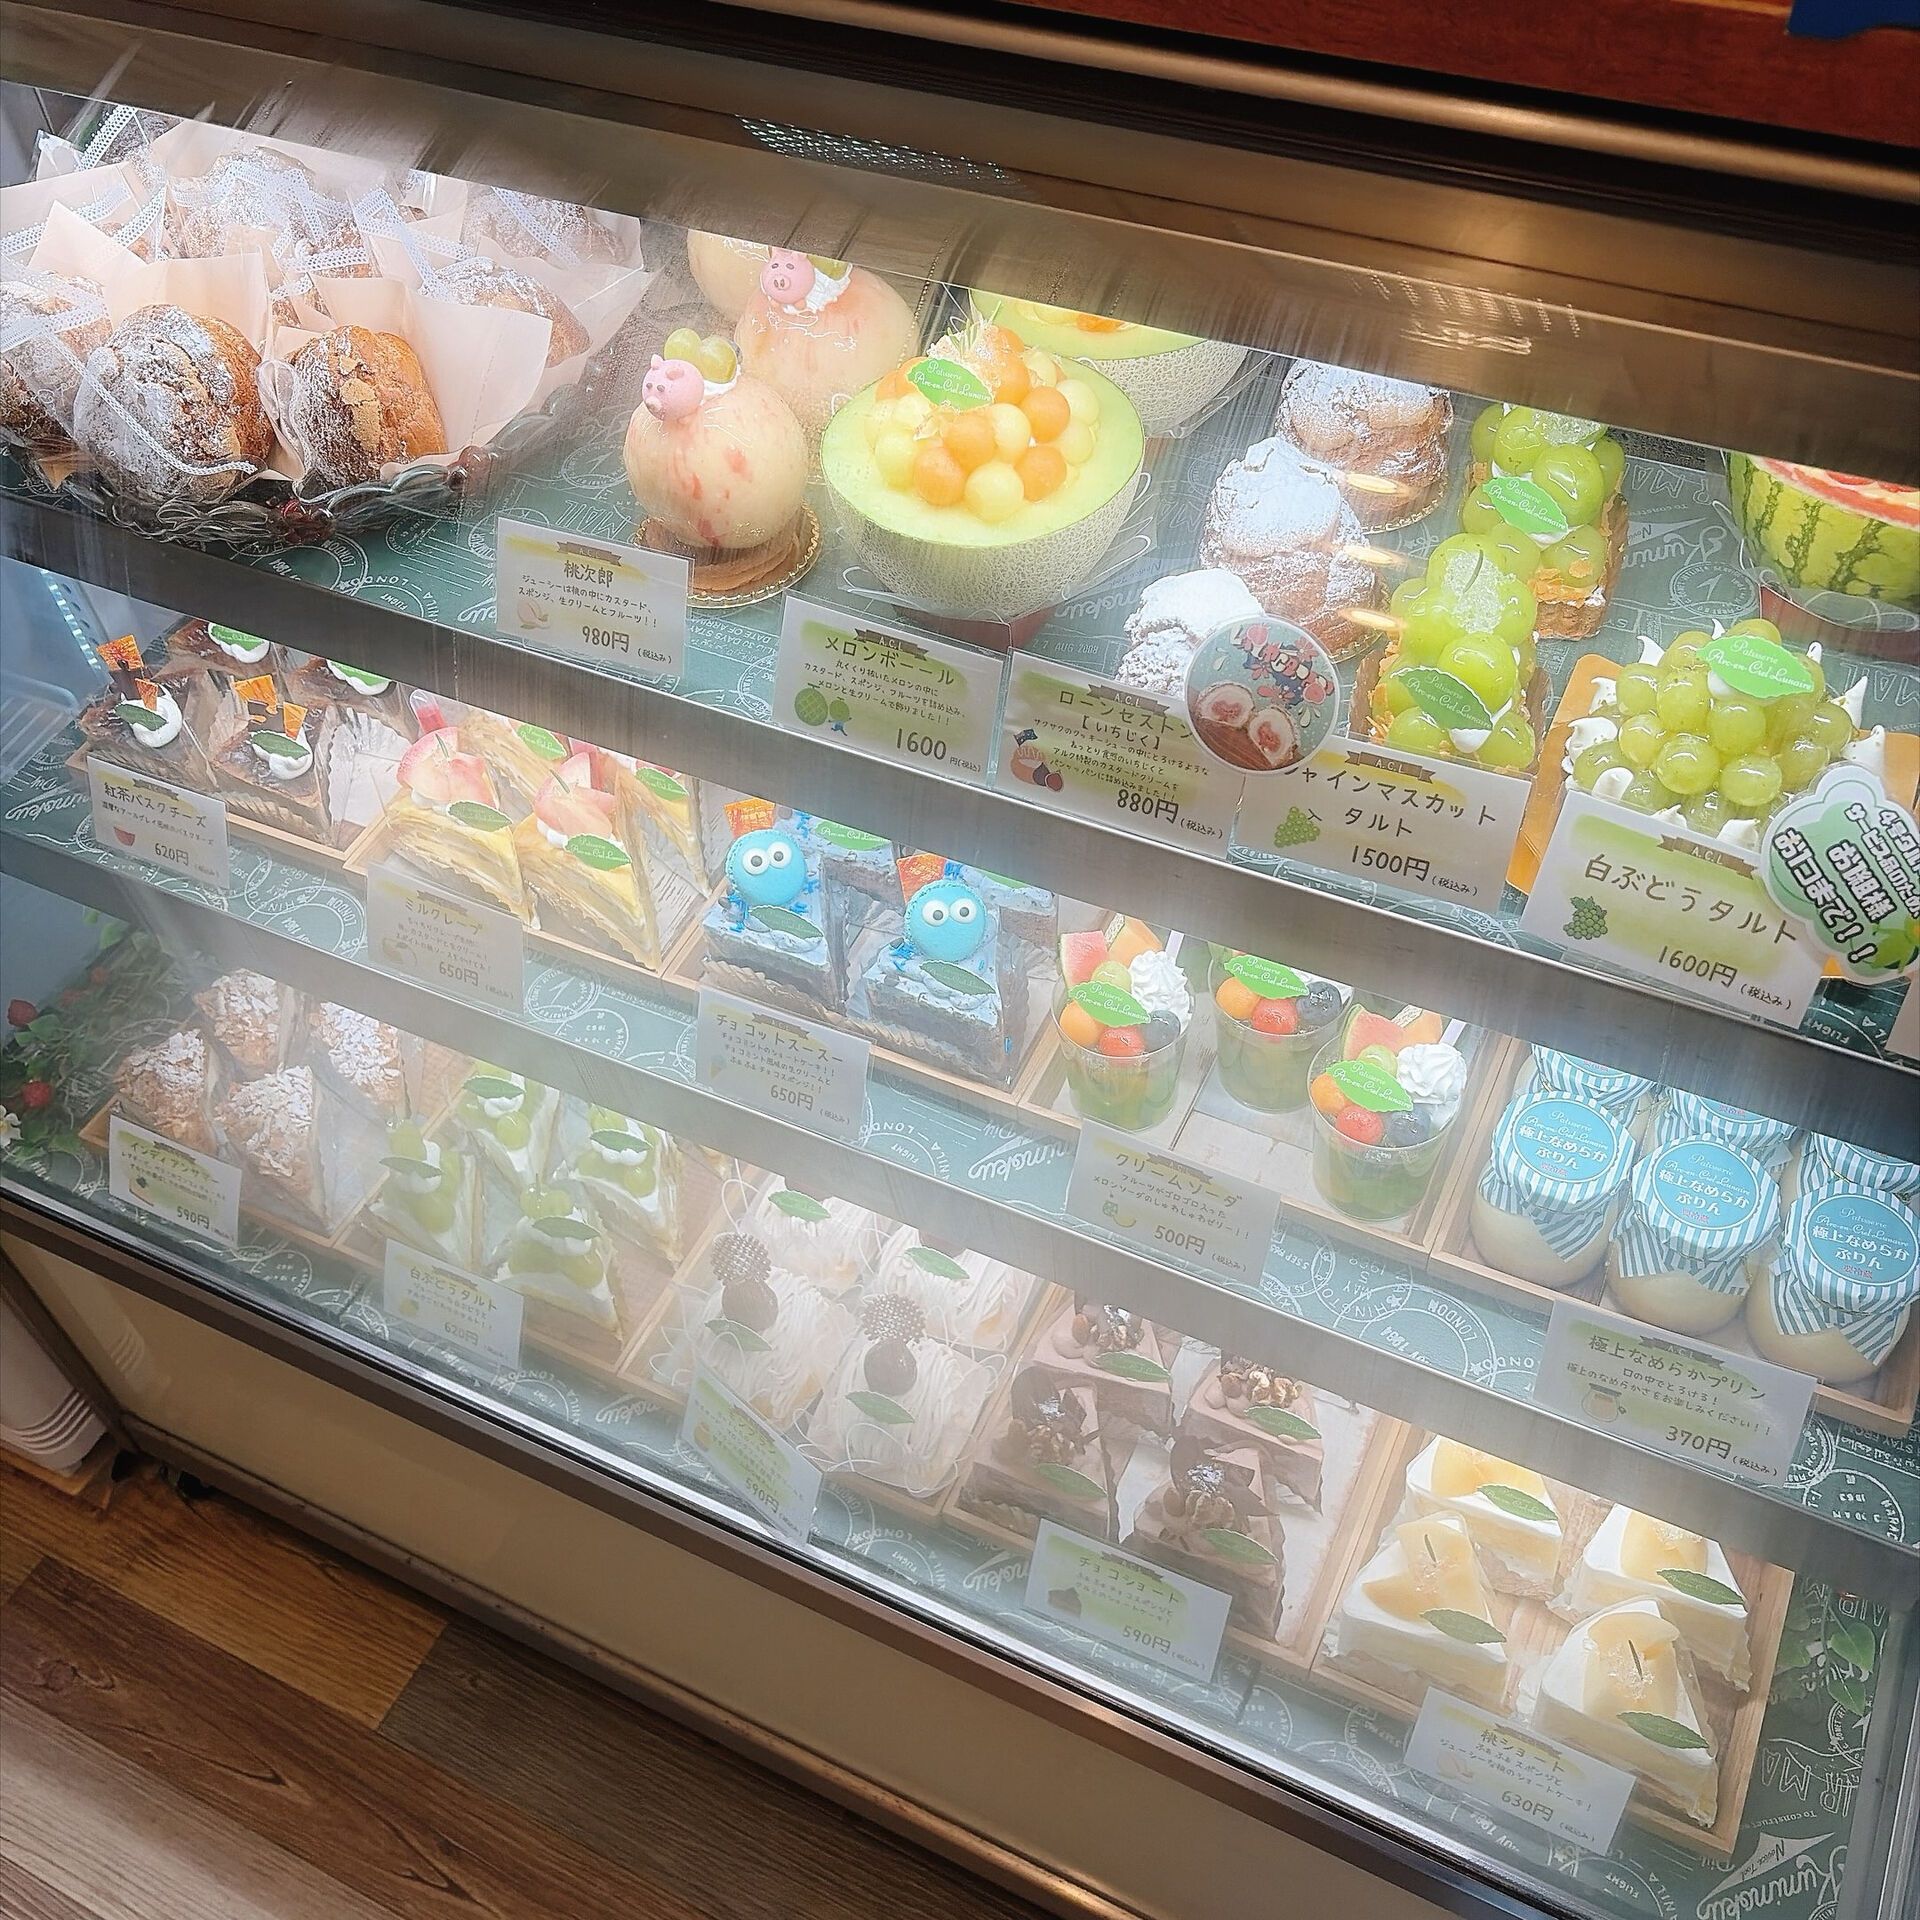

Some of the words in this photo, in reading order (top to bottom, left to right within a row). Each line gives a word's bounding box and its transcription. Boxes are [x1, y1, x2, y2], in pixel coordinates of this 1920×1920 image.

[564, 560, 613, 588] 桃次郎
[380, 593, 408, 612] FLIGHT
[582, 625, 630, 652] 980円
[728, 626, 743, 637] OF
[746, 631, 772, 643] DATE
[1732, 640, 1778, 664] Patisserie
[1770, 668, 1812, 690] Lunaire
[896, 728, 947, 761] 1600
[1080, 715, 1161, 750] 【いちじく】
[104, 782, 206, 828] 紅茶バスクチーズ
[1117, 789, 1179, 824] 880円
[1344, 807, 1413, 838] タルト
[154, 843, 188, 866] 620円
[1351, 845, 1431, 882] 1500円
[1690, 845, 1725, 865] A.C.L
[1584, 852, 1798, 946] 白ぶどうタルト
[405, 897, 483, 935] ミルクレープ
[439, 962, 478, 987] 650円
[1658, 944, 1738, 989] 1600円
[715, 1013, 843, 1063] チョコットスースー
[770, 1085, 814, 1111] 650円
[890, 1143, 920, 1164] FLIGHT
[1519, 1124, 1608, 1163] 極上なめらか
[1536, 1148, 1580, 1170] ぷりん
[1116, 1153, 1243, 1208] クリームソーダ
[1659, 1169, 1750, 1209] 極上なめらか
[177, 1206, 209, 1229] 590円
[1675, 1192, 1721, 1217] ぷりん
[1154, 1225, 1206, 1256] 500円
[1812, 1225, 1910, 1262] 極上なめらか
[1835, 1248, 1883, 1270] ぷりん
[410, 1266, 497, 1311] 白ぶどうタルト
[1426, 1299, 1478, 1342] LONDON
[1588, 1334, 1766, 1400] 極上なめらかプリン
[1665, 1425, 1732, 1460] 370円
[1079, 1557, 1179, 1604] チョコショート
[1122, 1626, 1171, 1653] 590円
[1480, 1729, 1565, 1774] 桃ショート
[1501, 1790, 1554, 1822] 630円
[1605, 1872, 1640, 1899] FLIGHT
